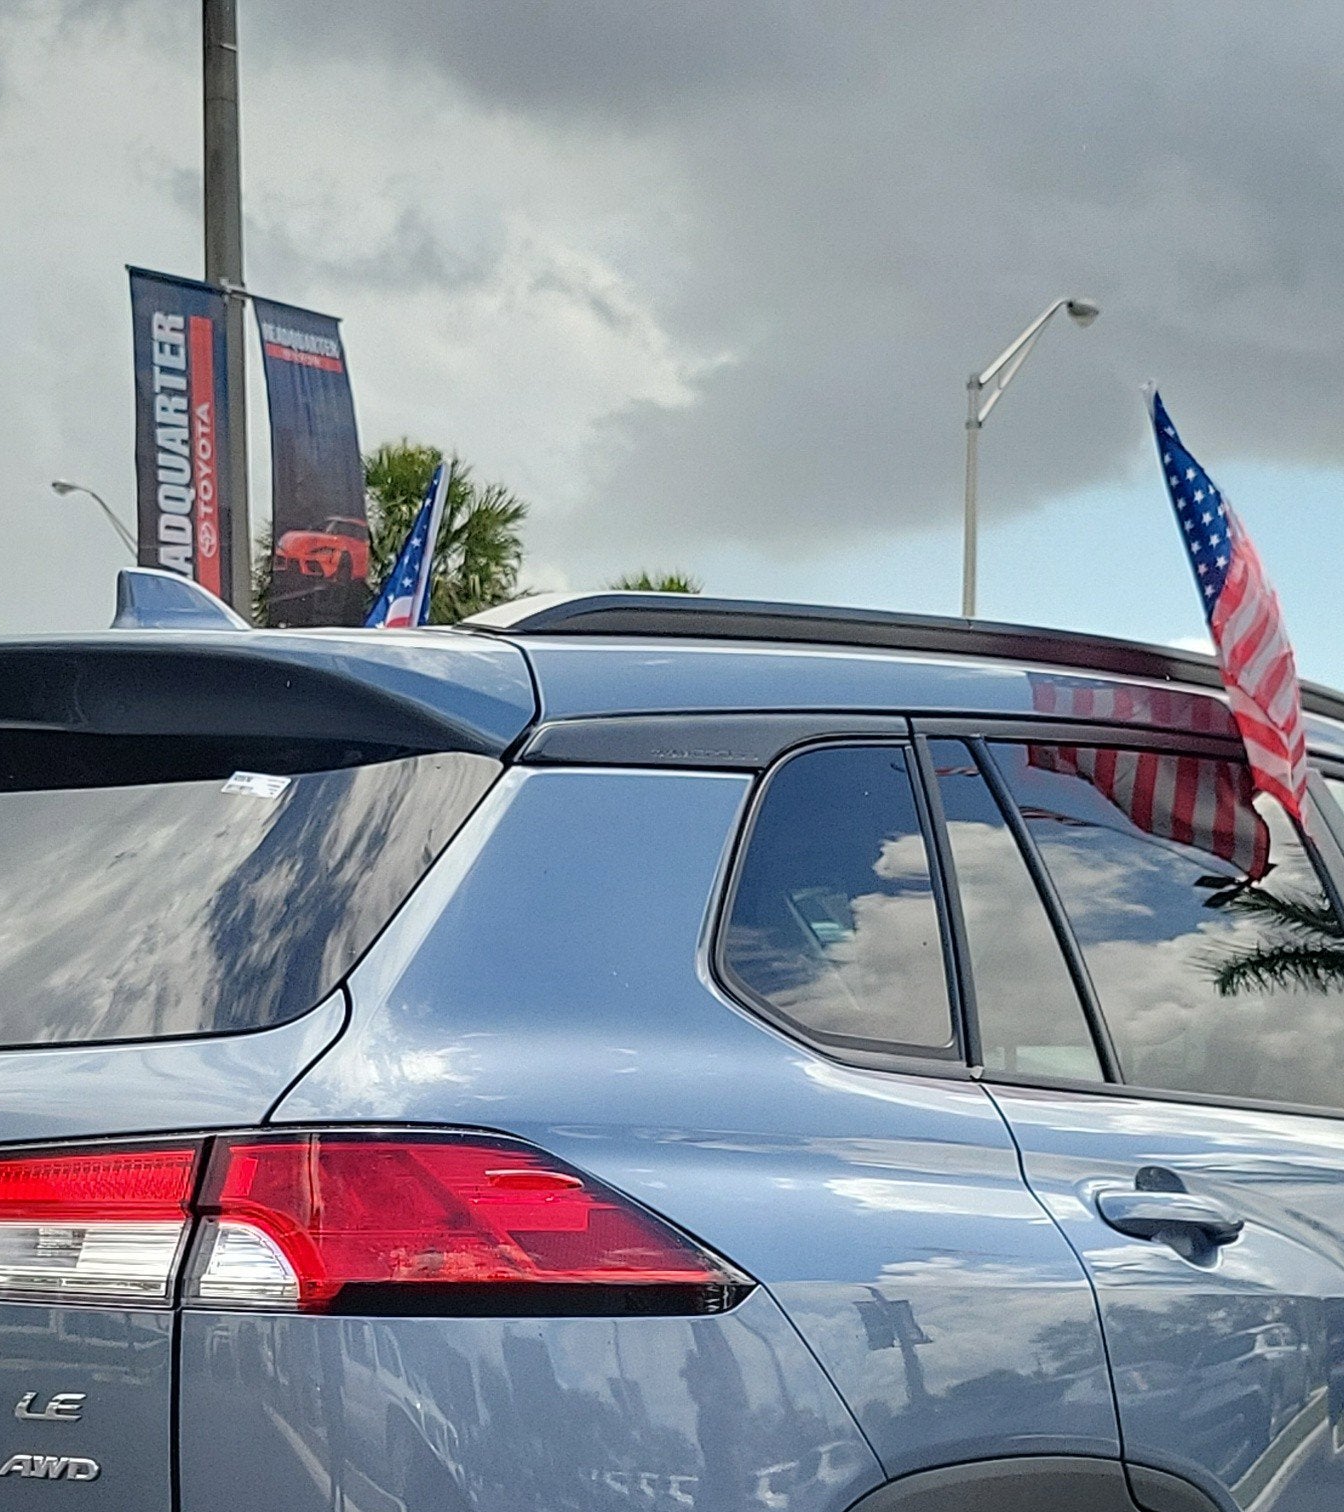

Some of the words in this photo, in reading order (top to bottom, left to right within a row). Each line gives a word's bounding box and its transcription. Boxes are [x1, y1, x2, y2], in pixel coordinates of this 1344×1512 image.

[152, 311, 194, 580] ADQUARTER
[196, 401, 215, 519] TOYOTA
[15, 1391, 86, 1421] LE
